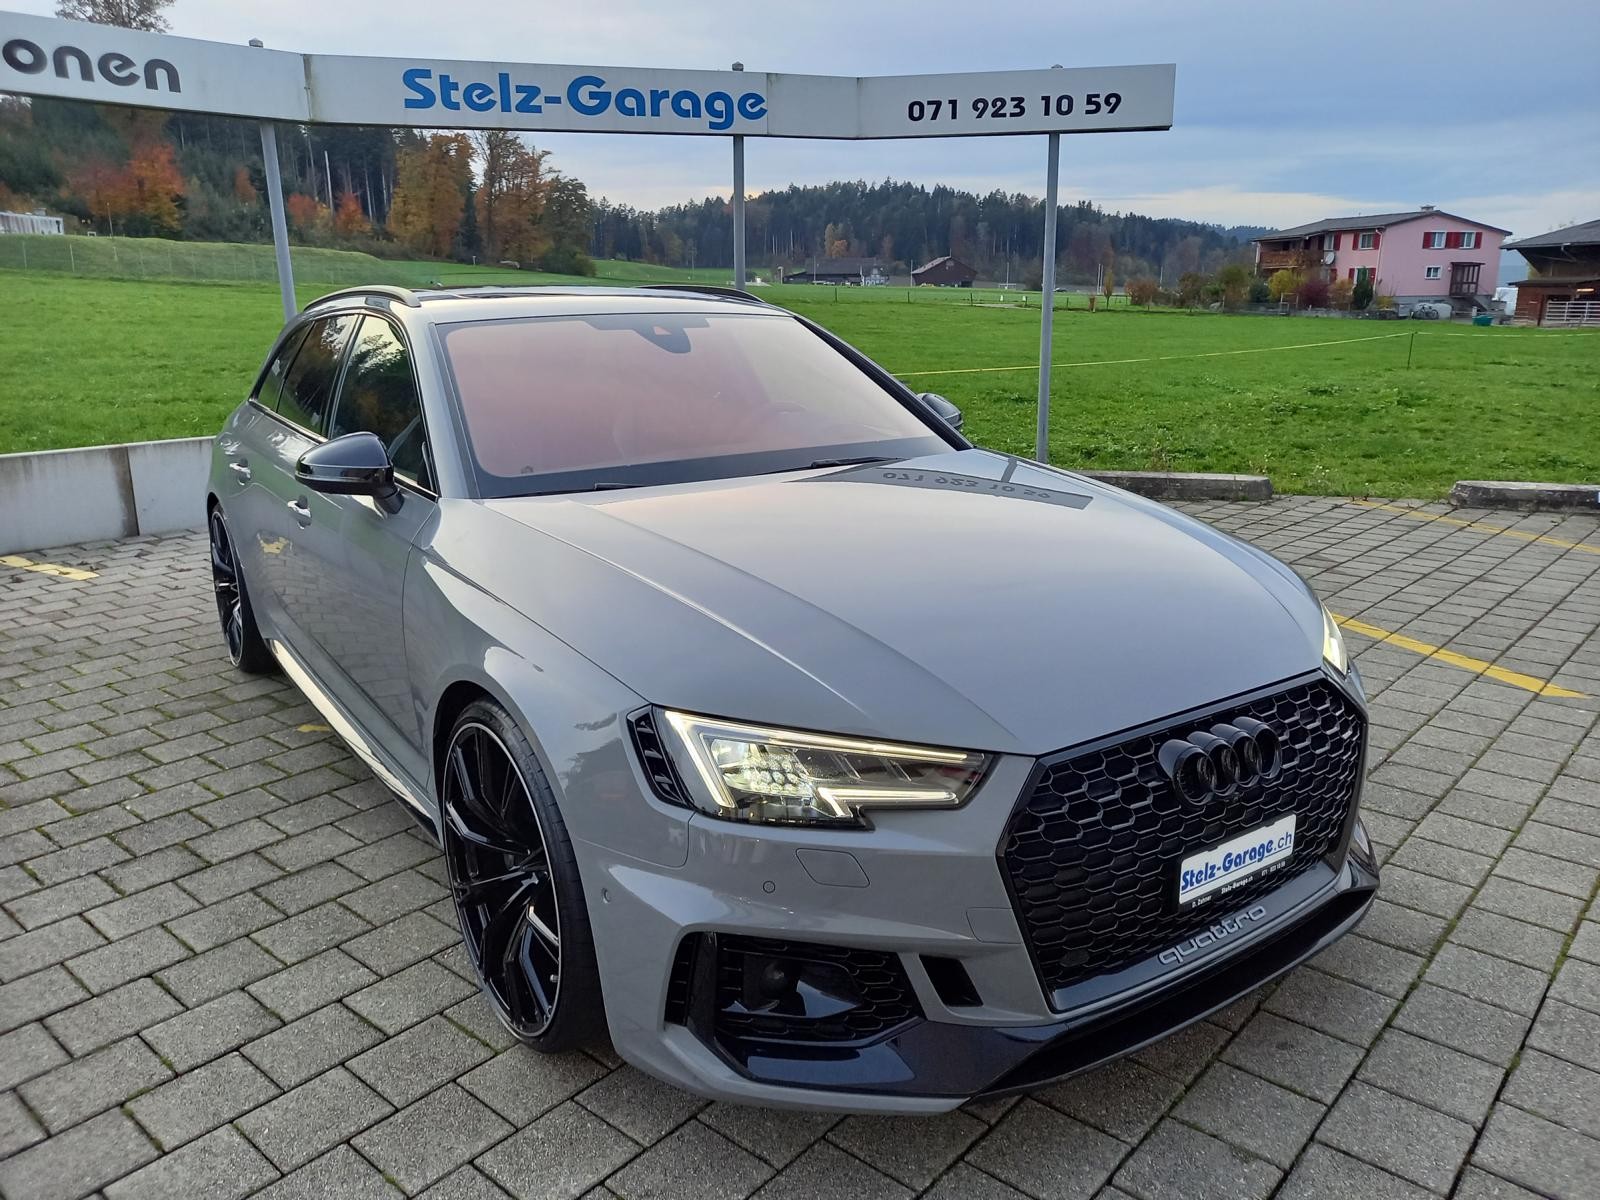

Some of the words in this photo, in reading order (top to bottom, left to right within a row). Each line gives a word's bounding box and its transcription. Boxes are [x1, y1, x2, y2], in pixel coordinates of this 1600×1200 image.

[2, 38, 182, 93] onen
[403, 68, 768, 130] Stelz-Garage
[908, 99, 958, 122] 071
[972, 96, 1026, 119] 923
[1041, 94, 1074, 117] 10
[1085, 92, 1123, 115] 59
[1181, 832, 1292, 891] Stelz-Garage.ch
[1159, 905, 1267, 965] quattro
